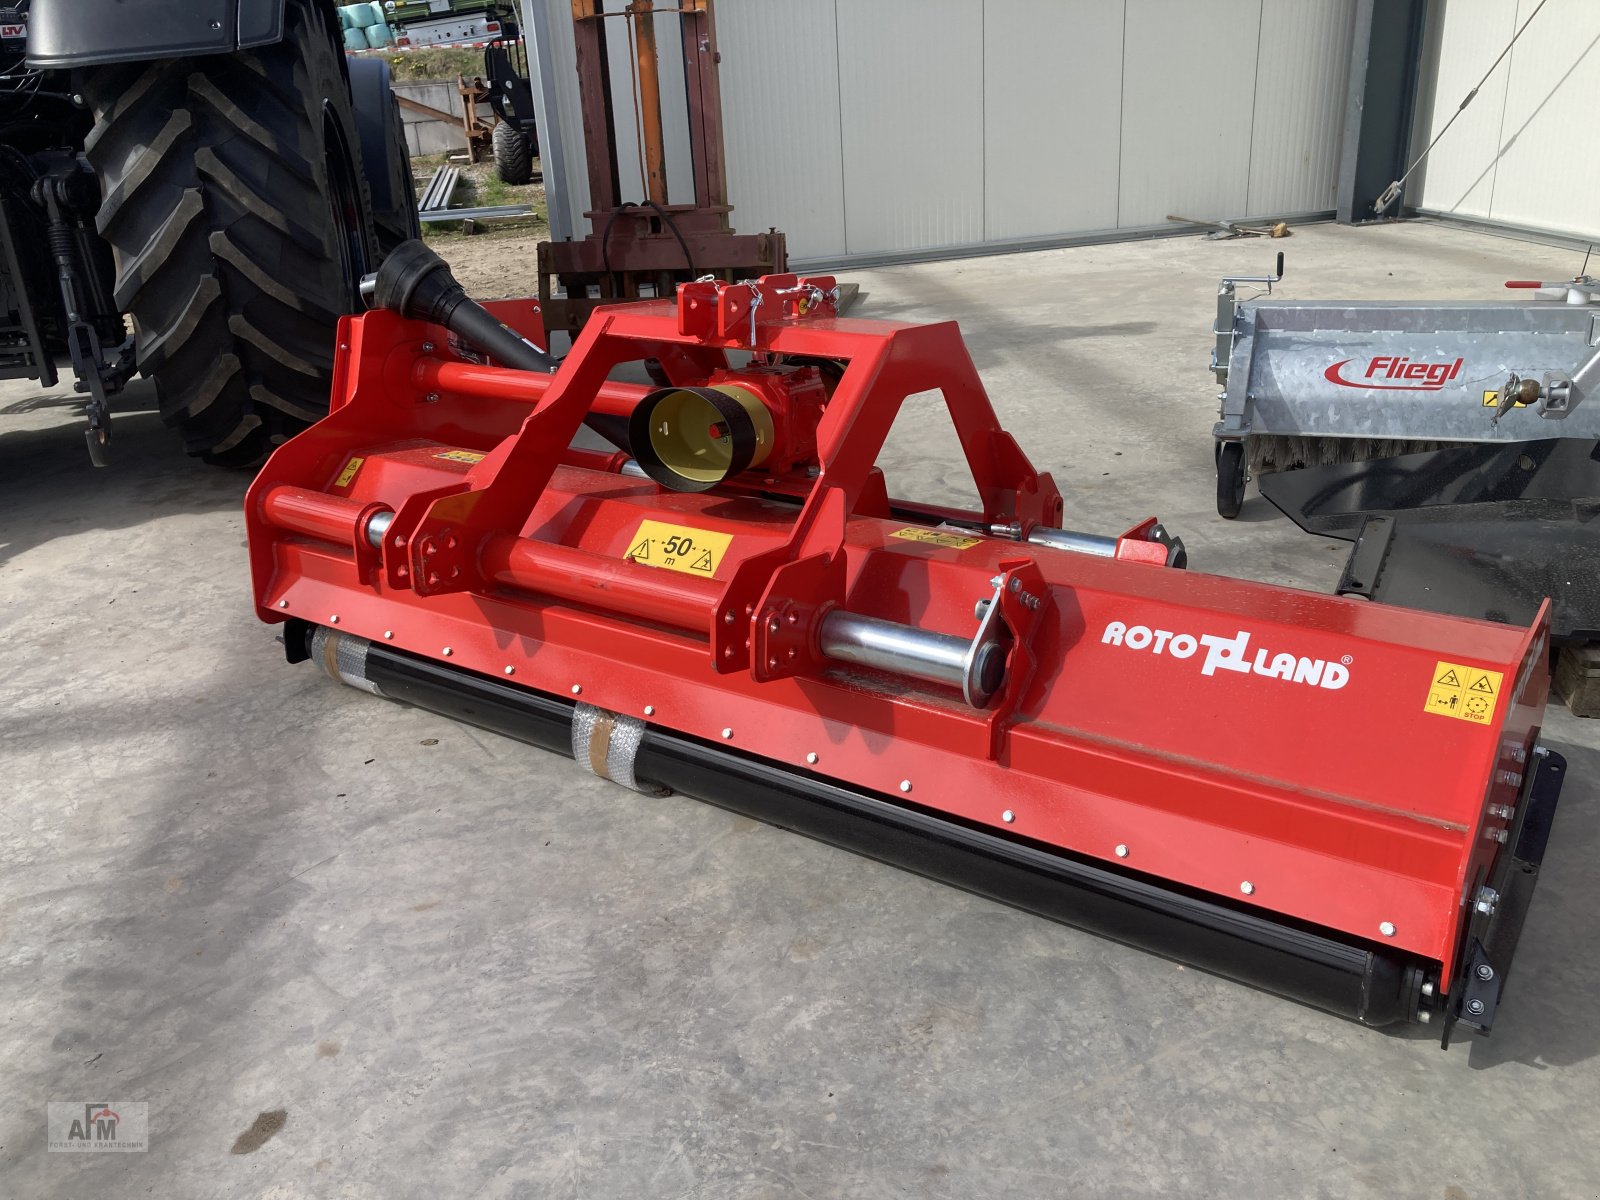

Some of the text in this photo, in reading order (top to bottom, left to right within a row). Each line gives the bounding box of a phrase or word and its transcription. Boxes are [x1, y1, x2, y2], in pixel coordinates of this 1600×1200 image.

[1364, 356, 1465, 386] Fliegl
[663, 535, 693, 557] 50
[664, 556, 676, 566] m
[1464, 712, 1485, 721] STOP
